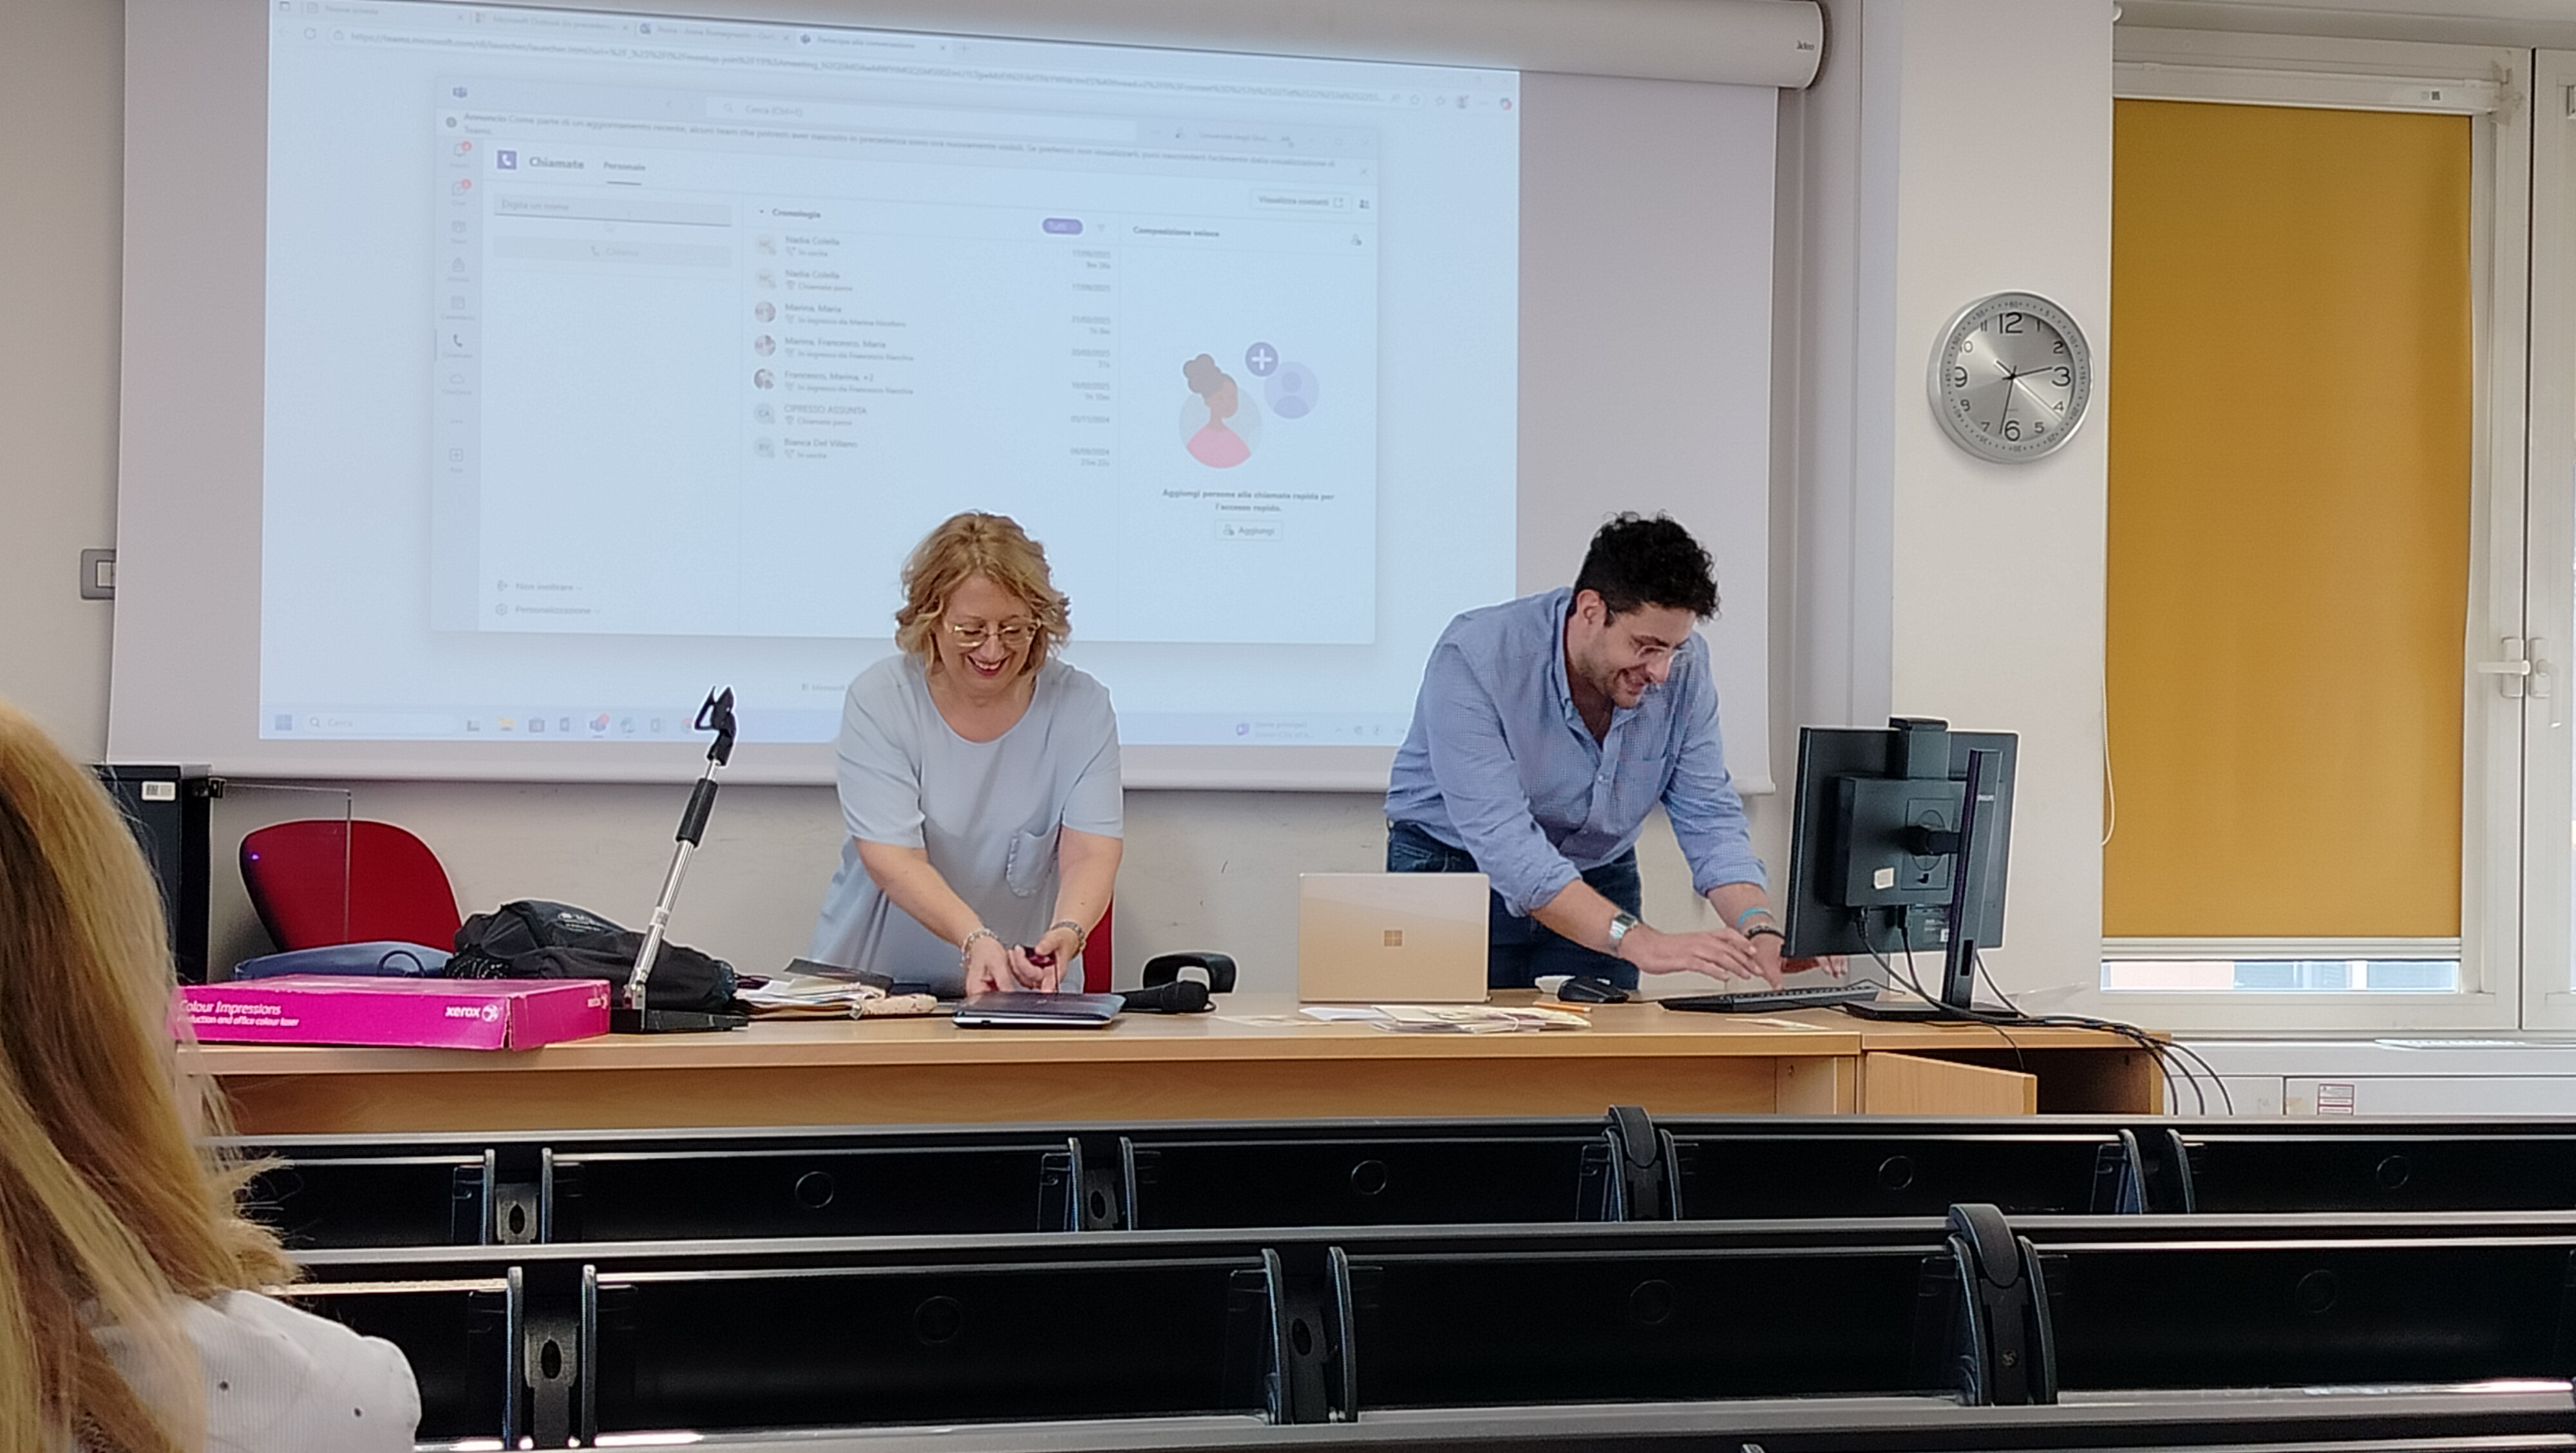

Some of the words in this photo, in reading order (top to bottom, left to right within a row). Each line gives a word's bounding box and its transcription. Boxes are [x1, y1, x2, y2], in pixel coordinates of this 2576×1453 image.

[529, 157, 584, 169] Chiamate
[603, 162, 646, 171] Personale
[1999, 312, 2023, 334] 12
[2052, 340, 2065, 354] 2
[1954, 365, 1968, 388] 9
[2051, 366, 2072, 387] 3
[784, 404, 825, 415] CIPRESSO
[828, 406, 867, 415] ASSUNTA
[1960, 399, 1971, 412] 8
[2052, 401, 2065, 412] 4
[1981, 421, 1991, 433] 7
[2004, 419, 2021, 442] 6
[2034, 422, 2045, 434] 5
[1238, 526, 1274, 537] Aggiungi
[516, 582, 535, 591] Non
[537, 582, 573, 592] inoltrare
[515, 605, 591, 615] Personalizzazione
[328, 718, 353, 728] Cerca
[216, 1001, 281, 1016] Impressions
[445, 1006, 480, 1018] xerox
[217, 1016, 232, 1025] and
[256, 1017, 279, 1027] colour
